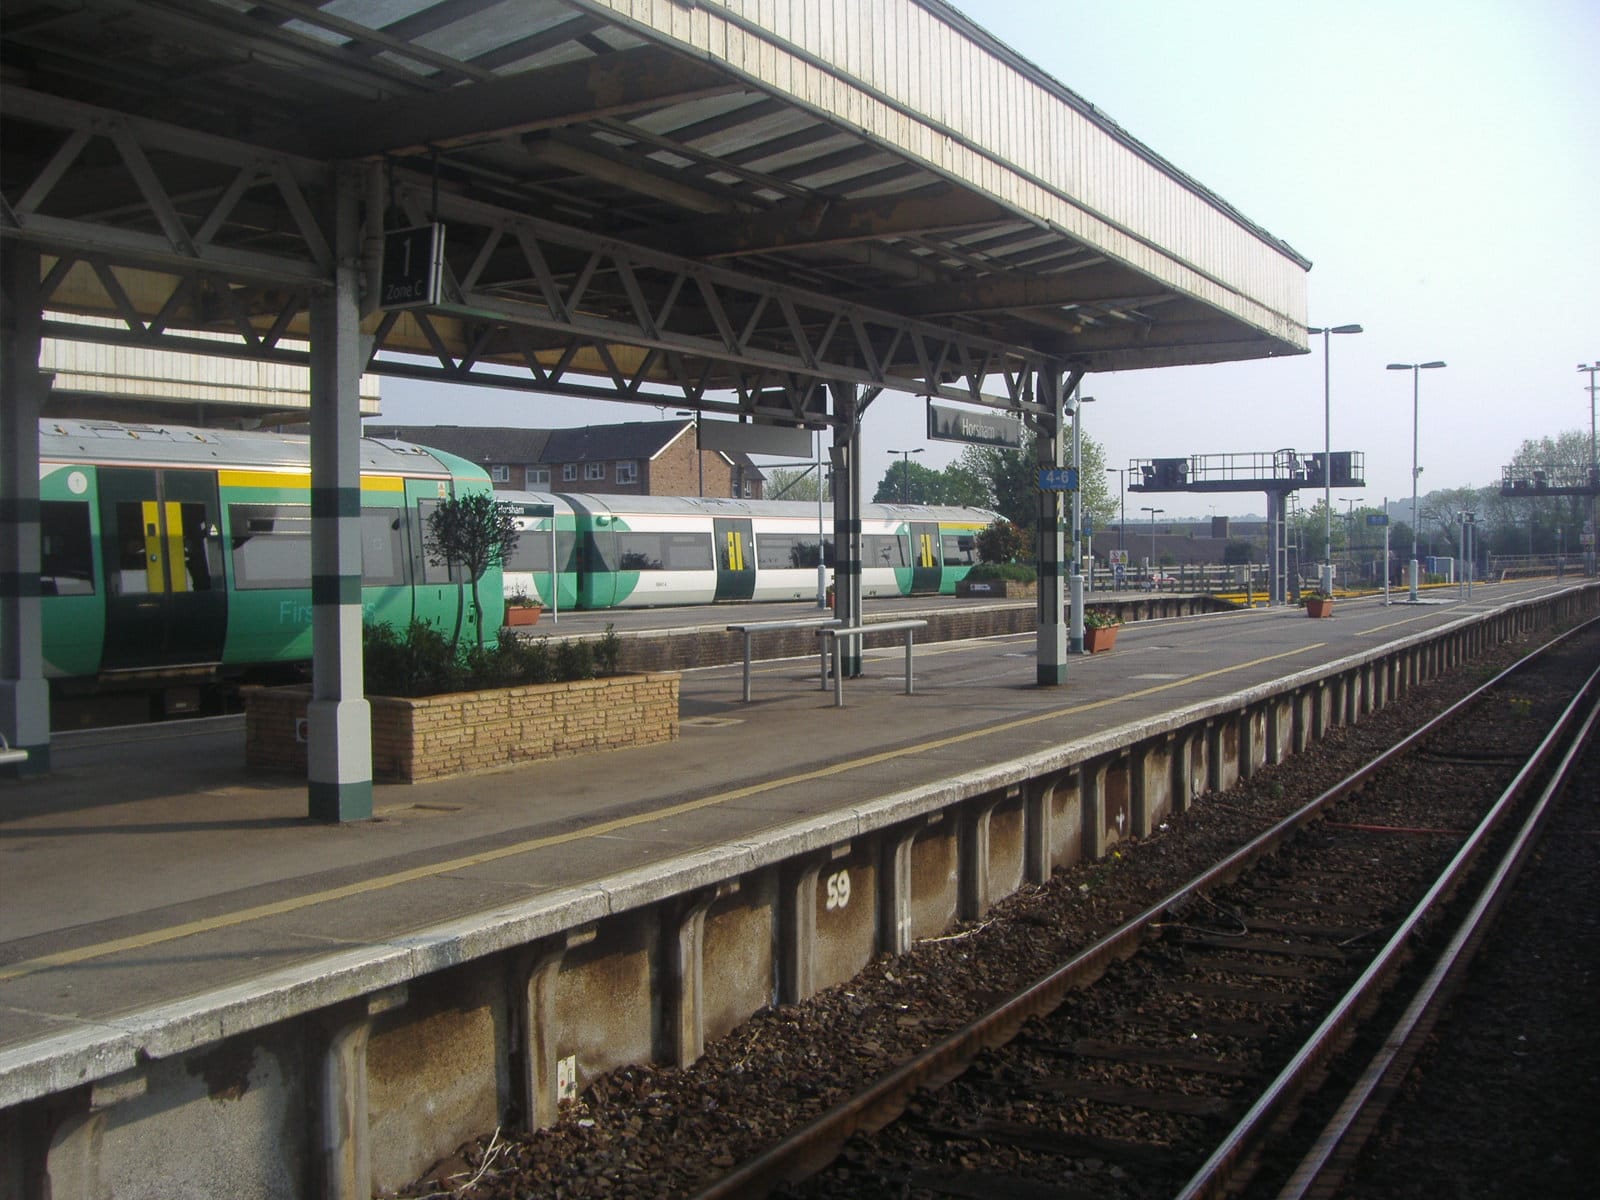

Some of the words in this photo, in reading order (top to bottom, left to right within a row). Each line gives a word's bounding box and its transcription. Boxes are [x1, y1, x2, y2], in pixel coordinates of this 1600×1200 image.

[403, 237, 411, 277] 1
[387, 284, 413, 300] Zone
[415, 280, 424, 296] C
[962, 418, 996, 440] Horsham
[1046, 470, 1070, 485] 4-6
[279, 600, 314, 625] Firs
[826, 869, 851, 910] 59
